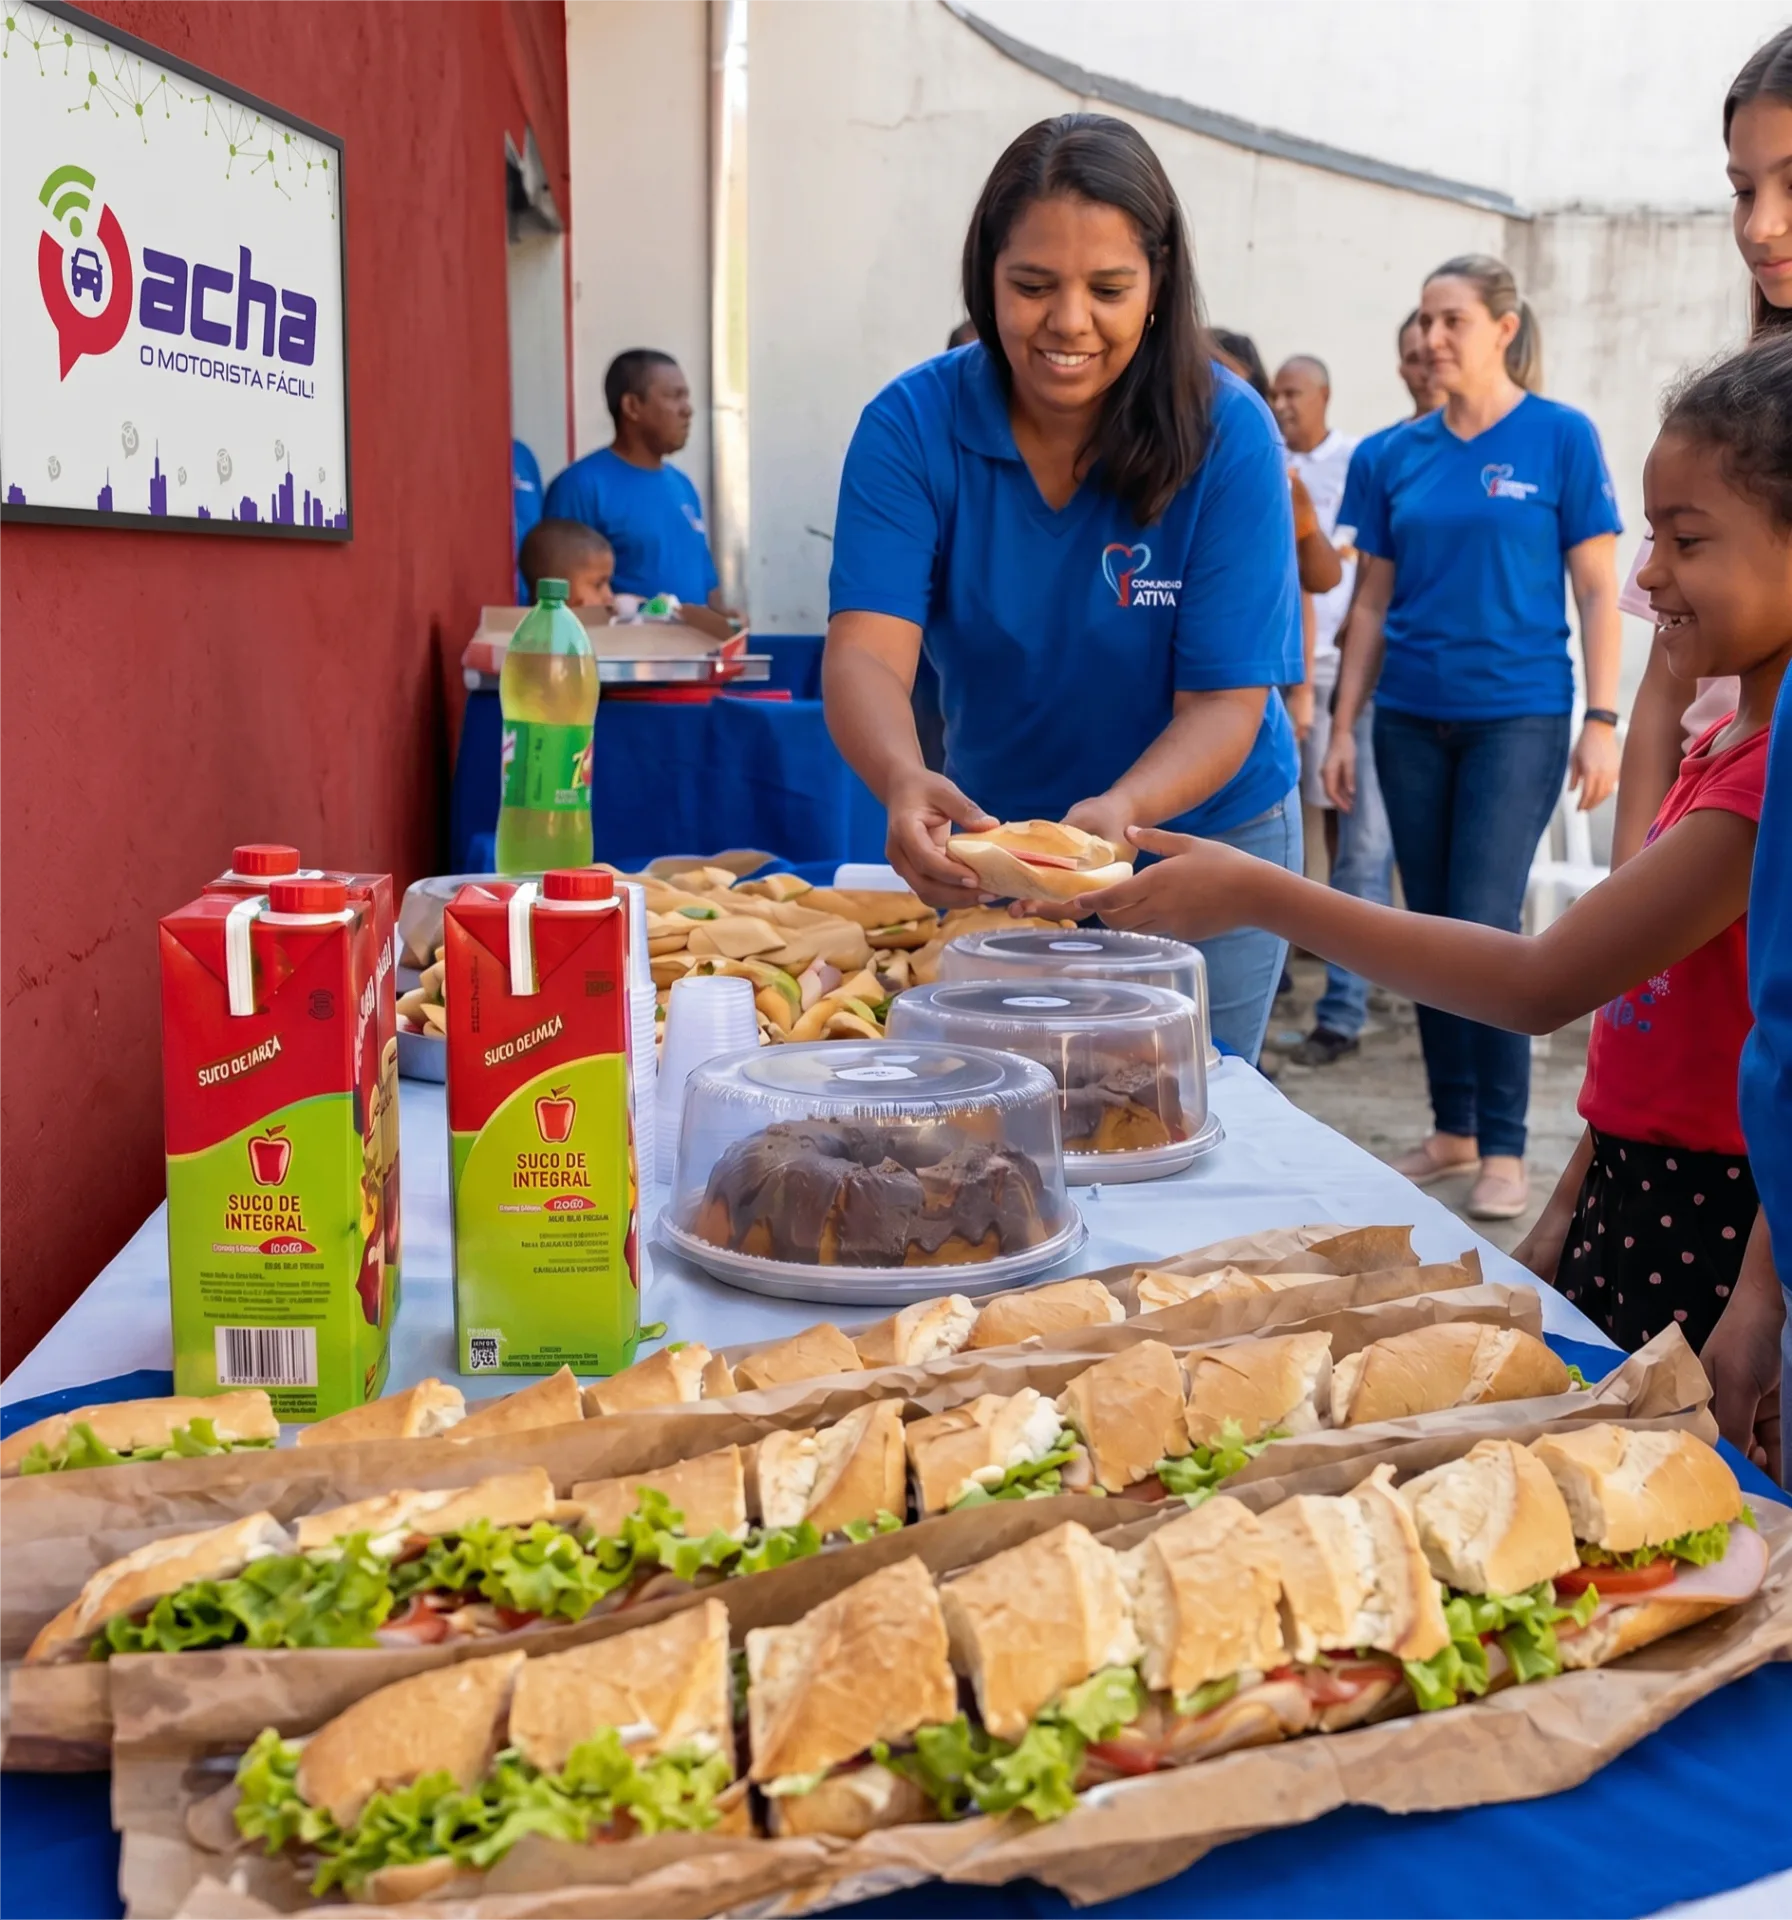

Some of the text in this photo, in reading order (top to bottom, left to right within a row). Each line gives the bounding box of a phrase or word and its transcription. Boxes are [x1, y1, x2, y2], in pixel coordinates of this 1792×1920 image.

[139, 244, 317, 367] acha
[140, 345, 315, 399] O MOTORISTA FÁCIL!
[1132, 590, 1177, 607] ATIVA
[484, 1042, 514, 1066] SUCO
[517, 1152, 586, 1169] SUCO DE
[513, 1170, 592, 1188] INTEGRAL
[228, 1194, 300, 1212] SUCO DE
[225, 1213, 307, 1232] INTEGRAL
